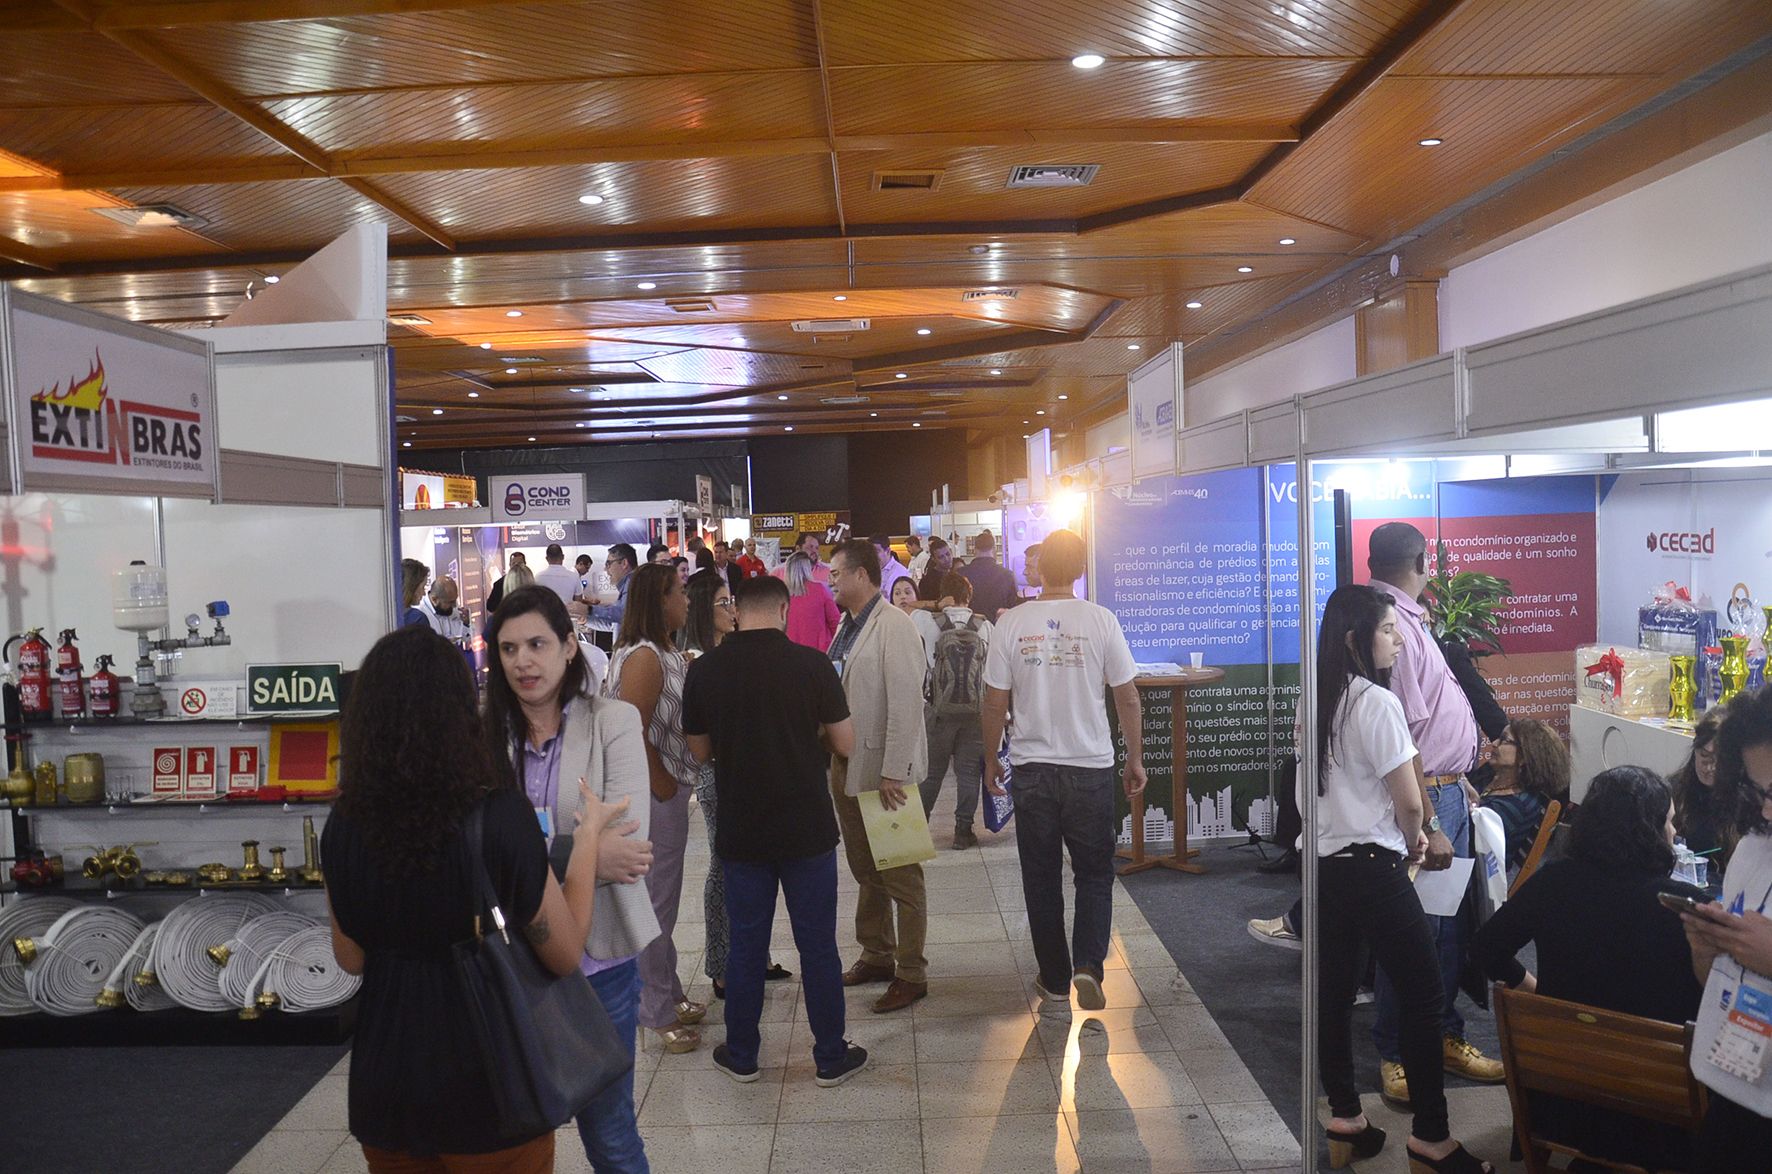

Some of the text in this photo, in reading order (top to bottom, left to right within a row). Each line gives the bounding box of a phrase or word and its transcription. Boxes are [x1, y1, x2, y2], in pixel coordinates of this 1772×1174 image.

[133, 457, 204, 472] EXTINTORES DO BRASIL
[528, 486, 570, 498] COND
[528, 498, 571, 507] CENTER
[762, 516, 793, 528] zanetti
[1453, 534, 1513, 547] condomínio
[1514, 532, 1569, 547] organizado
[1570, 534, 1577, 542] e
[1125, 546, 1146, 557] que
[1150, 546, 1158, 555] o
[1163, 542, 1190, 557] perfil
[1194, 542, 1208, 553] de
[1213, 540, 1257, 553] moradia
[1446, 551, 1460, 562] de
[1463, 548, 1512, 564] qualidade
[1515, 548, 1522, 560] é
[1525, 549, 1543, 559] um
[1546, 546, 1578, 558] sonho
[1114, 558, 1194, 574] predominância
[1199, 557, 1213, 569] de
[1217, 556, 1257, 570] prédios
[1114, 576, 1144, 587] áreas
[1146, 574, 1160, 586] de
[1162, 574, 1190, 586] lazer,
[1191, 574, 1214, 586] cuja
[1216, 572, 1251, 586] gestão
[1114, 589, 1185, 602] fissionalismo
[1186, 591, 1194, 600] e
[1195, 586, 1252, 599] eficiência?
[1253, 586, 1261, 598] E
[1285, 588, 1297, 597] as
[1506, 592, 1578, 605] contratar uma
[1115, 605, 1175, 617] nistradoras
[1177, 604, 1191, 616] de
[1192, 602, 1261, 615] condomínios
[1284, 604, 1292, 612] a
[1569, 606, 1578, 616] A
[1122, 621, 1157, 635] olução
[1161, 622, 1185, 634] para
[1188, 618, 1237, 632] qualificar
[1240, 620, 1248, 628] o
[1501, 622, 1508, 635] é
[1509, 622, 1555, 634] imediata.
[1131, 632, 1251, 649] seu empreendimento?
[1505, 673, 1518, 685] de
[253, 670, 336, 704] SAÍDA
[1189, 686, 1232, 698] contrata
[1234, 686, 1257, 696] uma
[1513, 690, 1532, 700] nas
[1534, 686, 1577, 700] questões
[1215, 703, 1223, 712] o
[1227, 700, 1264, 711] síndico
[1544, 704, 1551, 712] e
[1143, 719, 1167, 730] lidar
[1194, 716, 1241, 730] questões
[1243, 714, 1268, 726] mais
[1198, 735, 1217, 743] seu
[1219, 730, 1252, 744] prédio
[1208, 746, 1222, 758] de
[1223, 748, 1254, 757] novos
[1206, 763, 1219, 773] os
